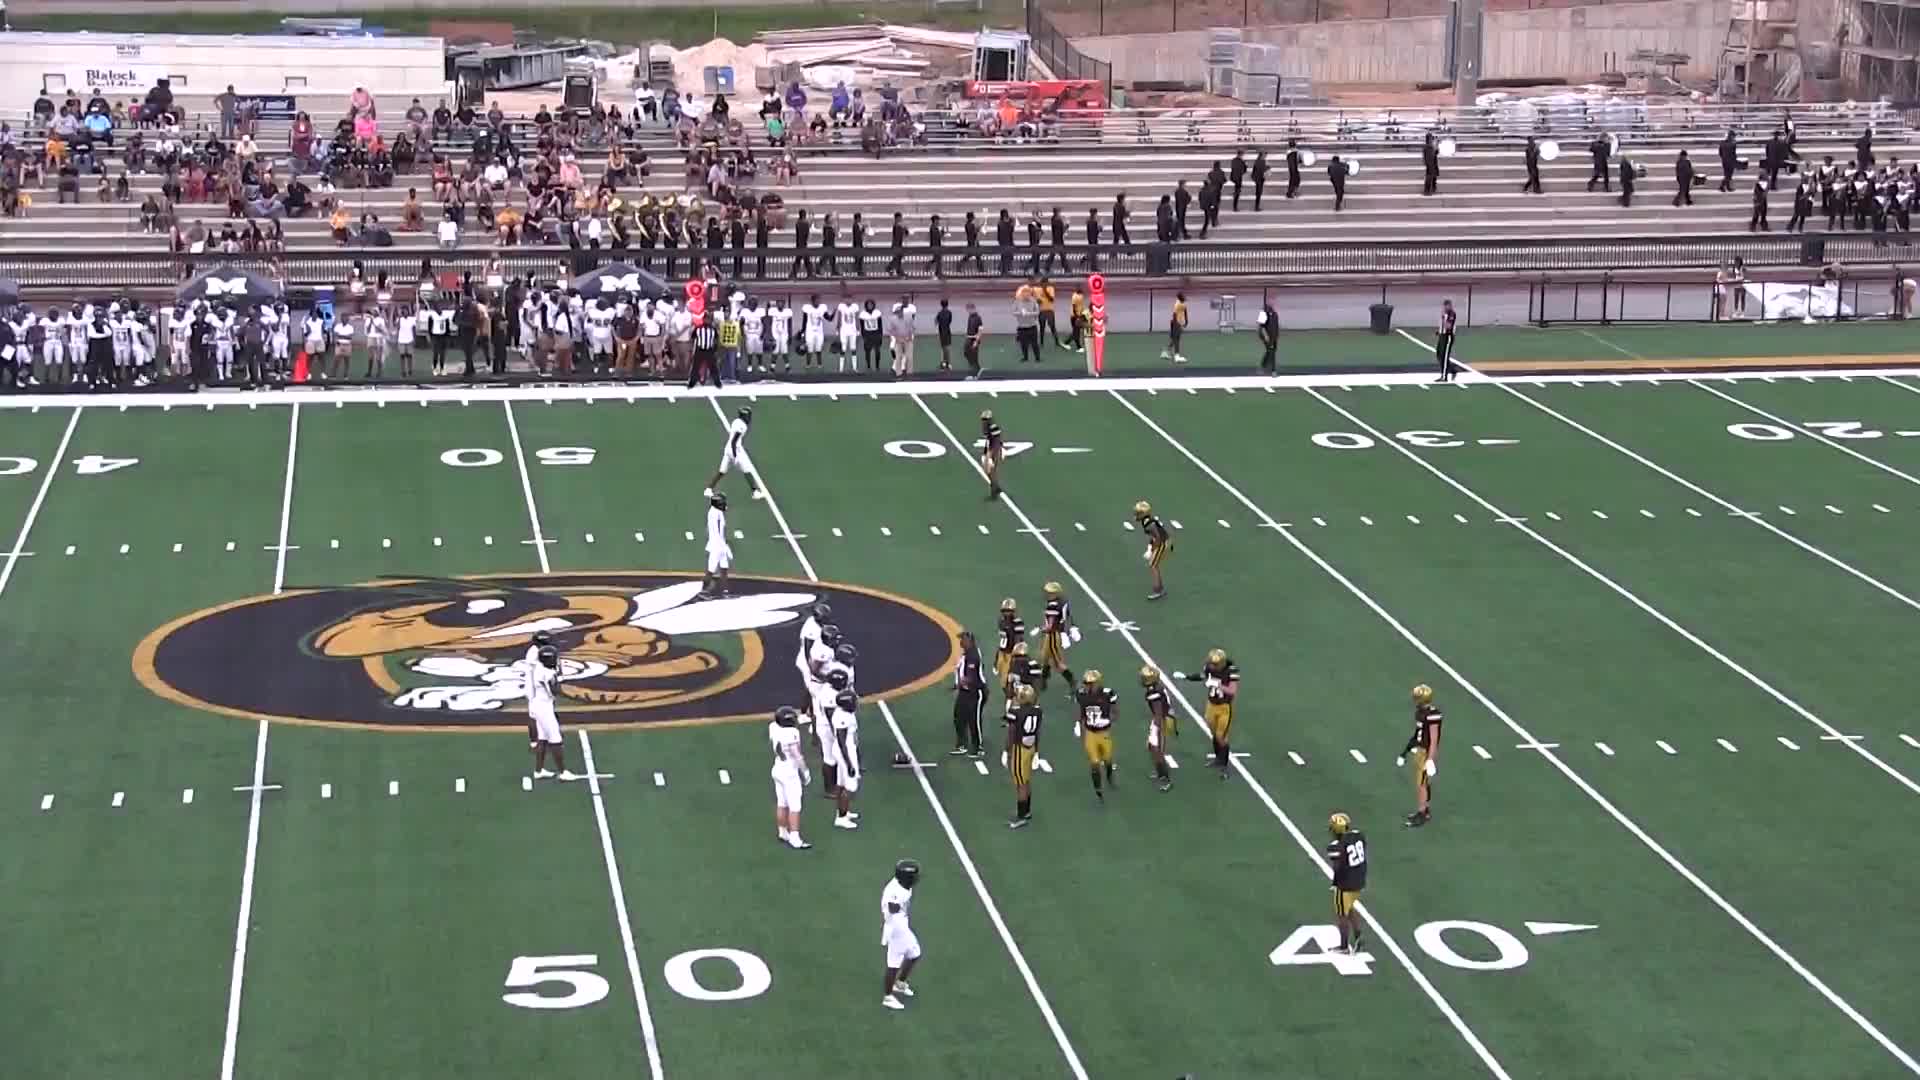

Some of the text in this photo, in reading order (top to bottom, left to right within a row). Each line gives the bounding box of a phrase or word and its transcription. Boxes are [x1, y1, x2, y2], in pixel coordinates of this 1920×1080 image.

[86, 69, 136, 80] Blalock
[205, 277, 248, 295] M
[1346, 840, 1365, 867] 28
